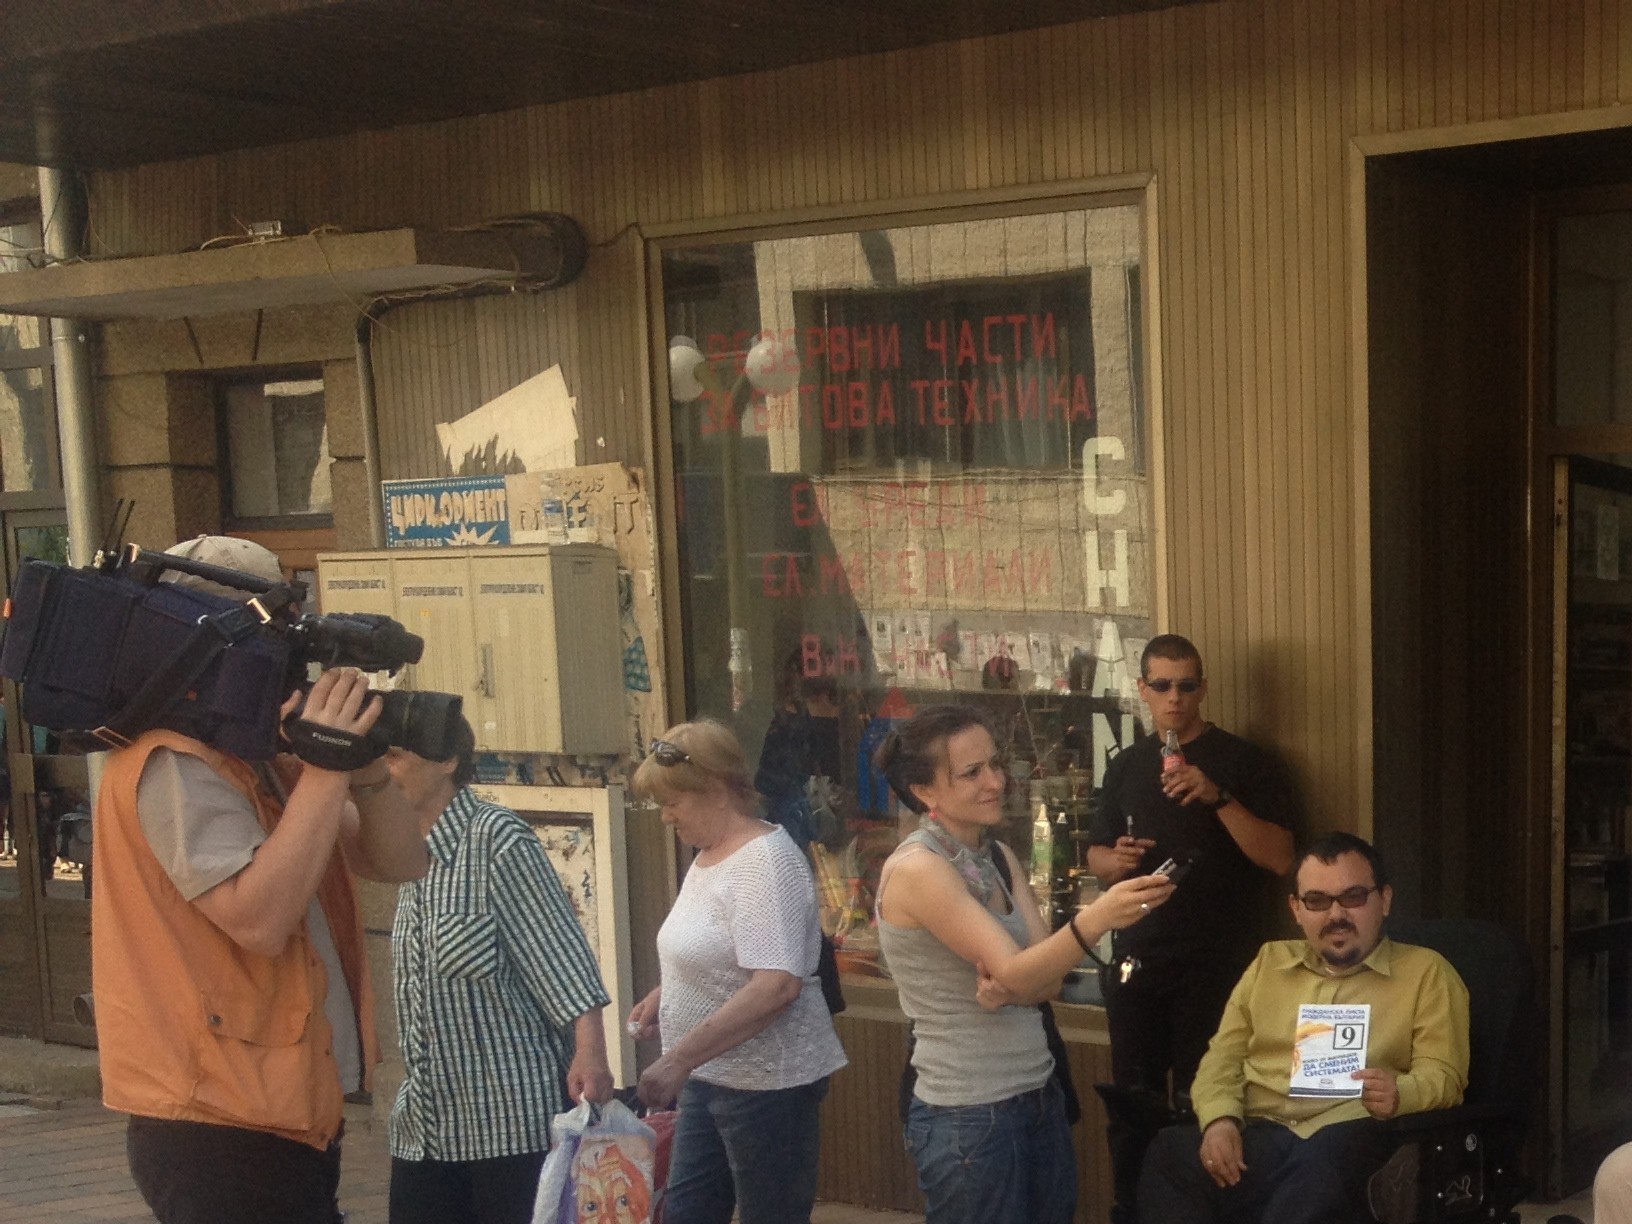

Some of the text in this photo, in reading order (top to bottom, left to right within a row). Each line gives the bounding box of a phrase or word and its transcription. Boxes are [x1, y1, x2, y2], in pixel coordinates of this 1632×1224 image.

[707, 312, 1057, 376] РЕЗЕРВНИ ЧАСТИ
[753, 376, 896, 431] БИТОВА
[911, 374, 1094, 425] ТЕХНИКА
[1341, 1026, 1356, 1048] 9
[1304, 1065, 1361, 1077] СИСТЕМАТА!
[1318, 1056, 1360, 1069] СМЕНИМ
